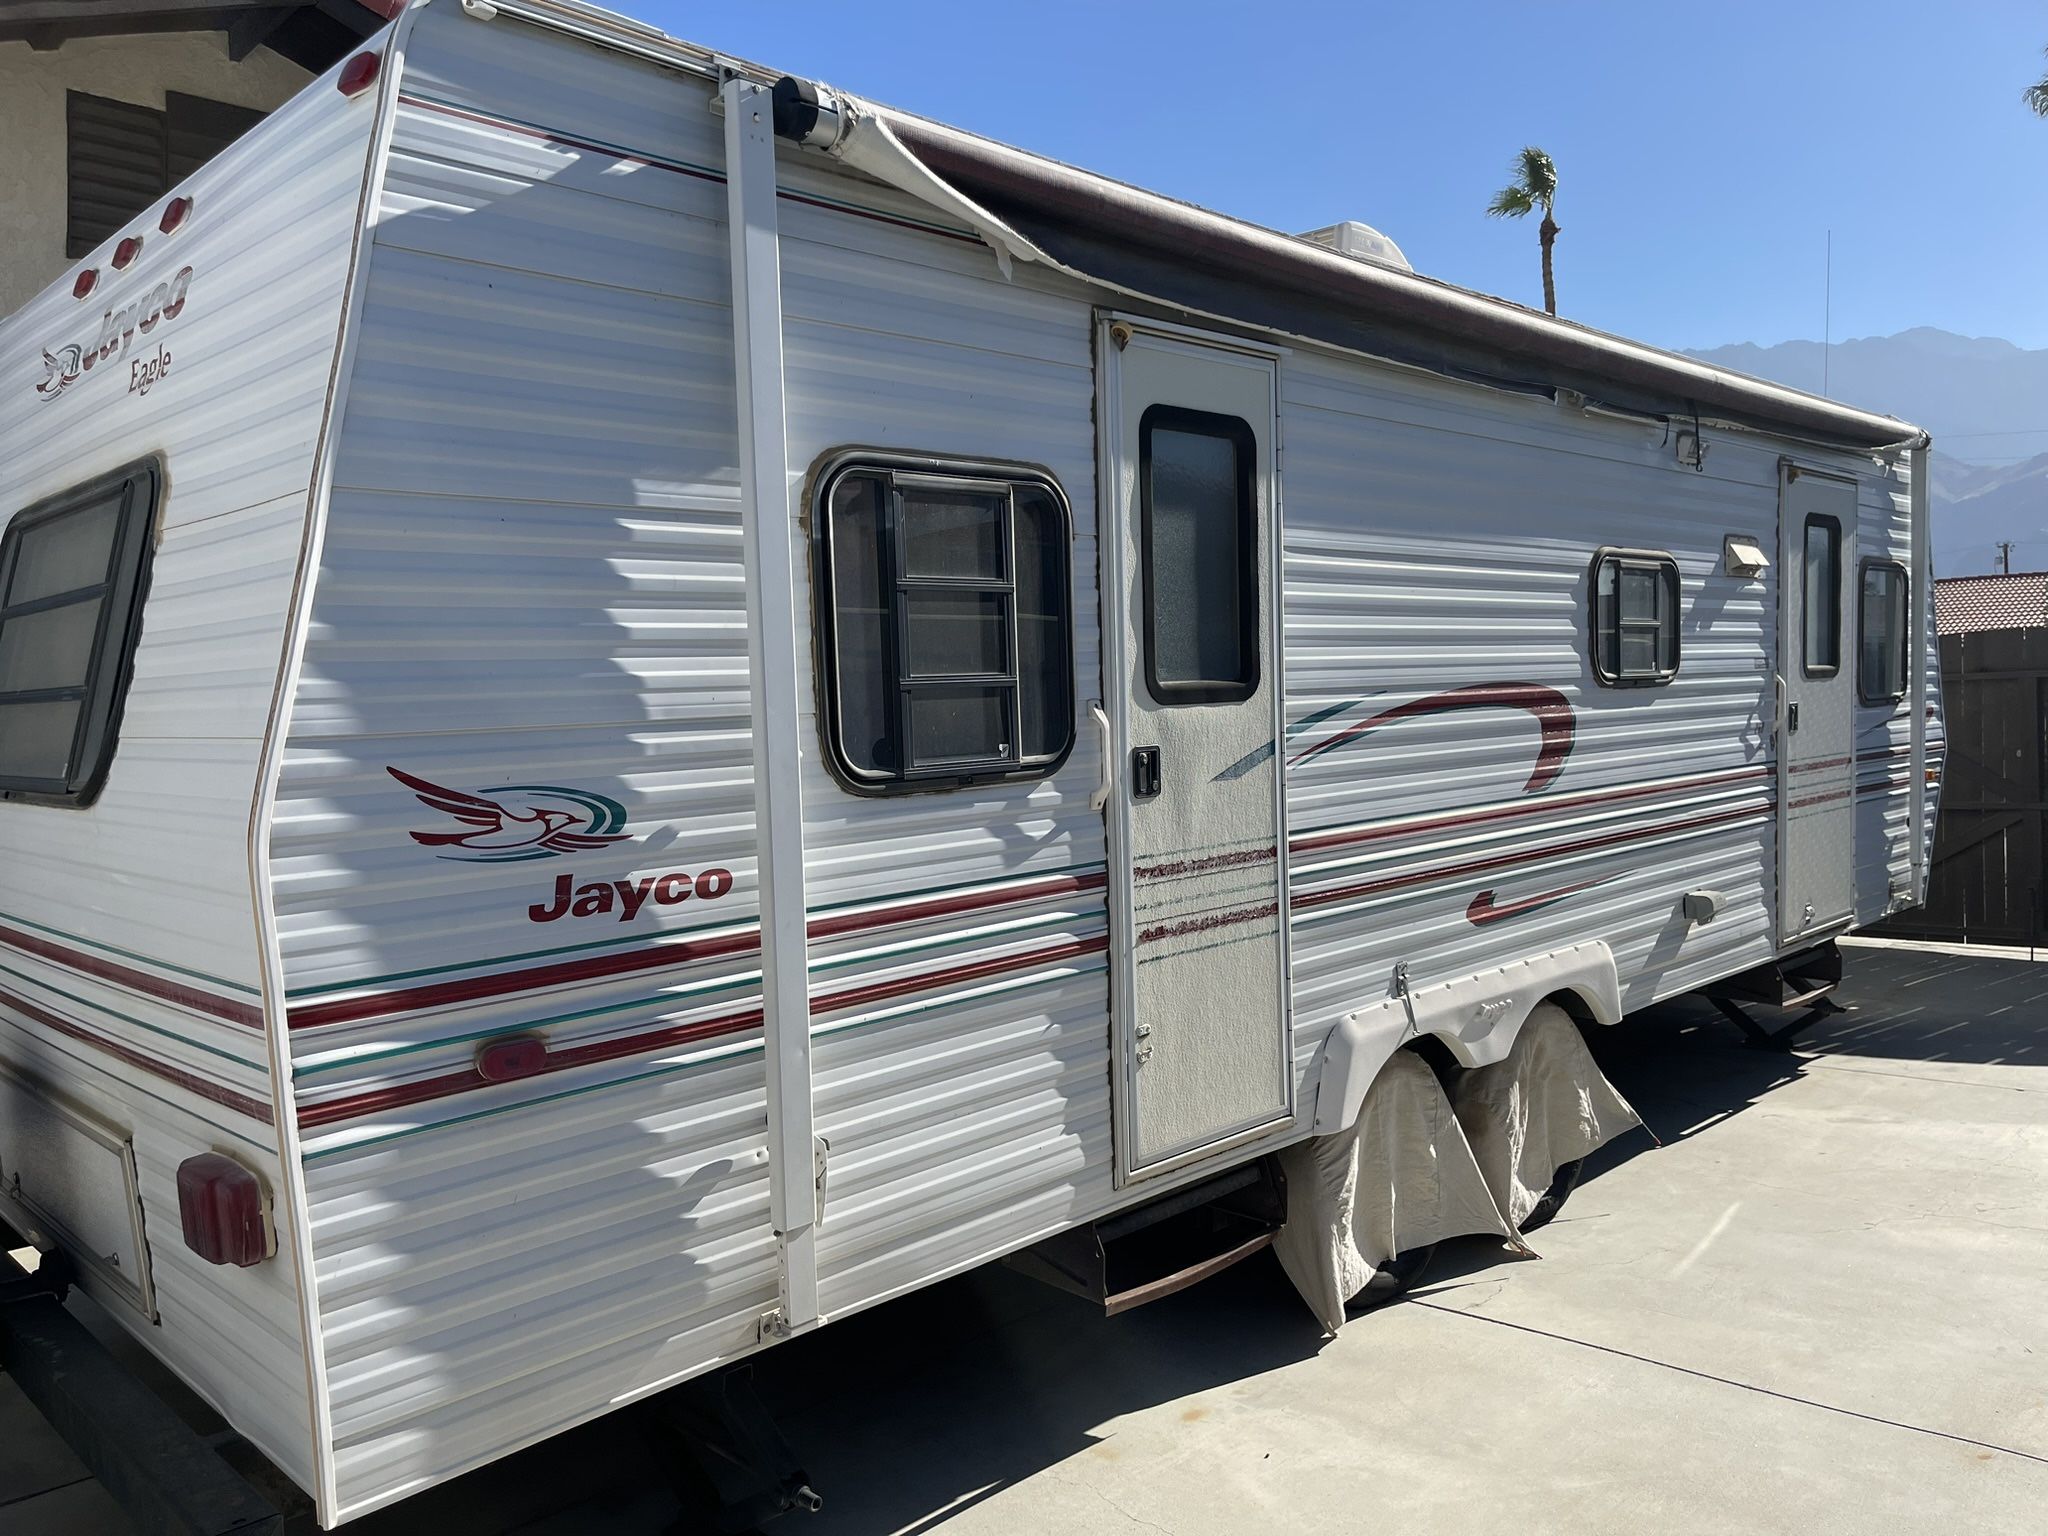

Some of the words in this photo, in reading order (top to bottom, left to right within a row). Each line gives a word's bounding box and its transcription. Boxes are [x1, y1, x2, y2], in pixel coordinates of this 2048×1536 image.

[83, 266, 193, 371] Jayco
[128, 343, 171, 396] Eagle
[528, 868, 733, 922] Jayco
